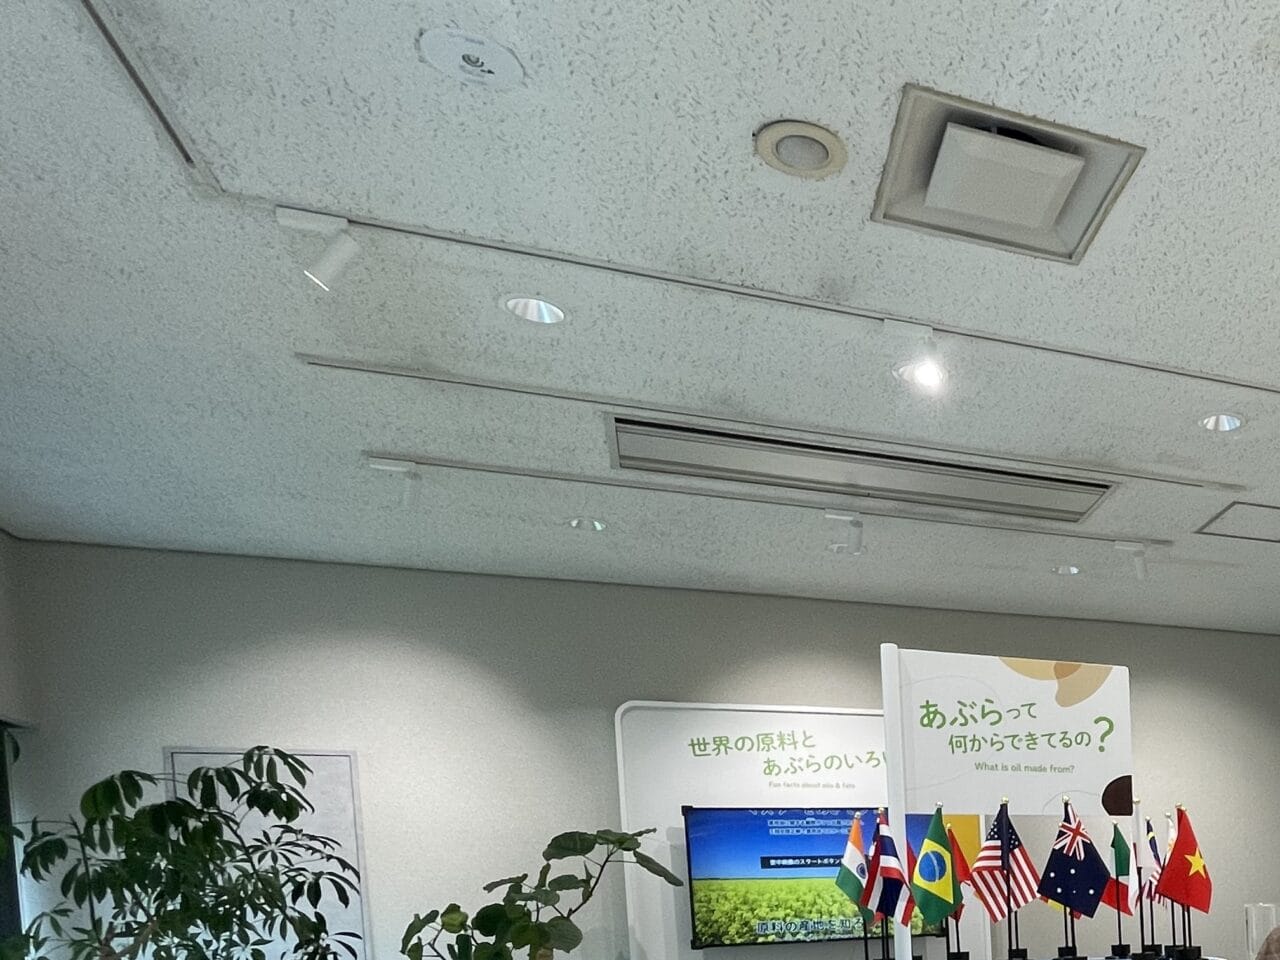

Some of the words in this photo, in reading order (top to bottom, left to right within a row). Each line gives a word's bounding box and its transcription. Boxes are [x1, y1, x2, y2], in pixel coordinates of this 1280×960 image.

[919, 698, 1037, 729] あぶらって
[688, 730, 816, 757] 世界の原料と
[948, 716, 1115, 754] 何からできてるの？
[974, 762, 998, 772] What
[1001, 763, 1009, 772] is
[1011, 764, 1022, 772] oil
[1024, 764, 1047, 773] made
[1050, 764, 1075, 774] from?
